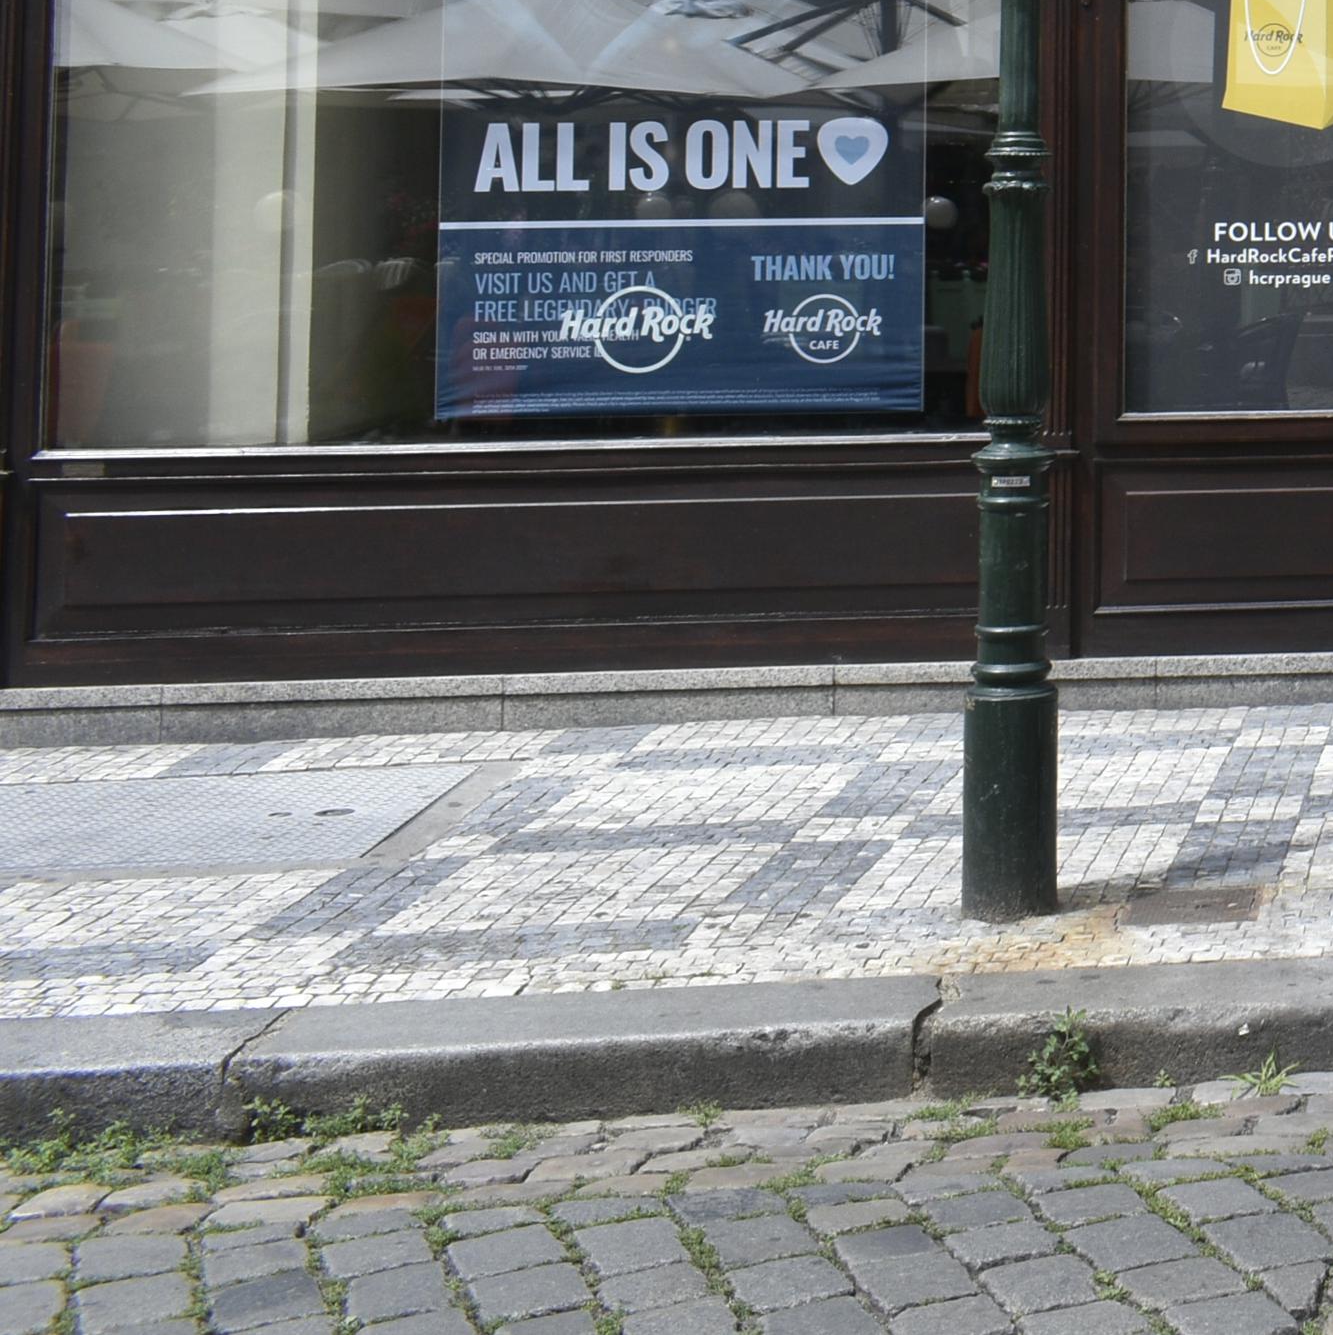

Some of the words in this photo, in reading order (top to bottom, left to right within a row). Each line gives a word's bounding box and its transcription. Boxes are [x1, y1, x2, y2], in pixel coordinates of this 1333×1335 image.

[475, 121, 589, 192] ALL
[609, 120, 668, 192] IS
[685, 118, 809, 190] ONE
[1214, 221, 1320, 241] FOLLOW
[474, 251, 512, 264] SPECIAL
[517, 250, 575, 263] PROMOTION
[578, 250, 597, 263] FOR
[600, 250, 626, 263] FIRST
[630, 249, 692, 262] RESPONDERS
[751, 254, 831, 281] THANK
[840, 253, 894, 280] YOU!
[475, 272, 521, 295] VISIT
[527, 272, 553, 294] US
[558, 272, 597, 293] AND
[603, 271, 638, 293] GET
[644, 270, 656, 289] A
[1249, 269, 1330, 288] hcrprague
[475, 300, 518, 322] FREE
[763, 309, 824, 333] Hard
[825, 308, 882, 336] Rock
[559, 307, 638, 340] Hard
[641, 305, 714, 342] Rock
[809, 340, 840, 350] CAFE
